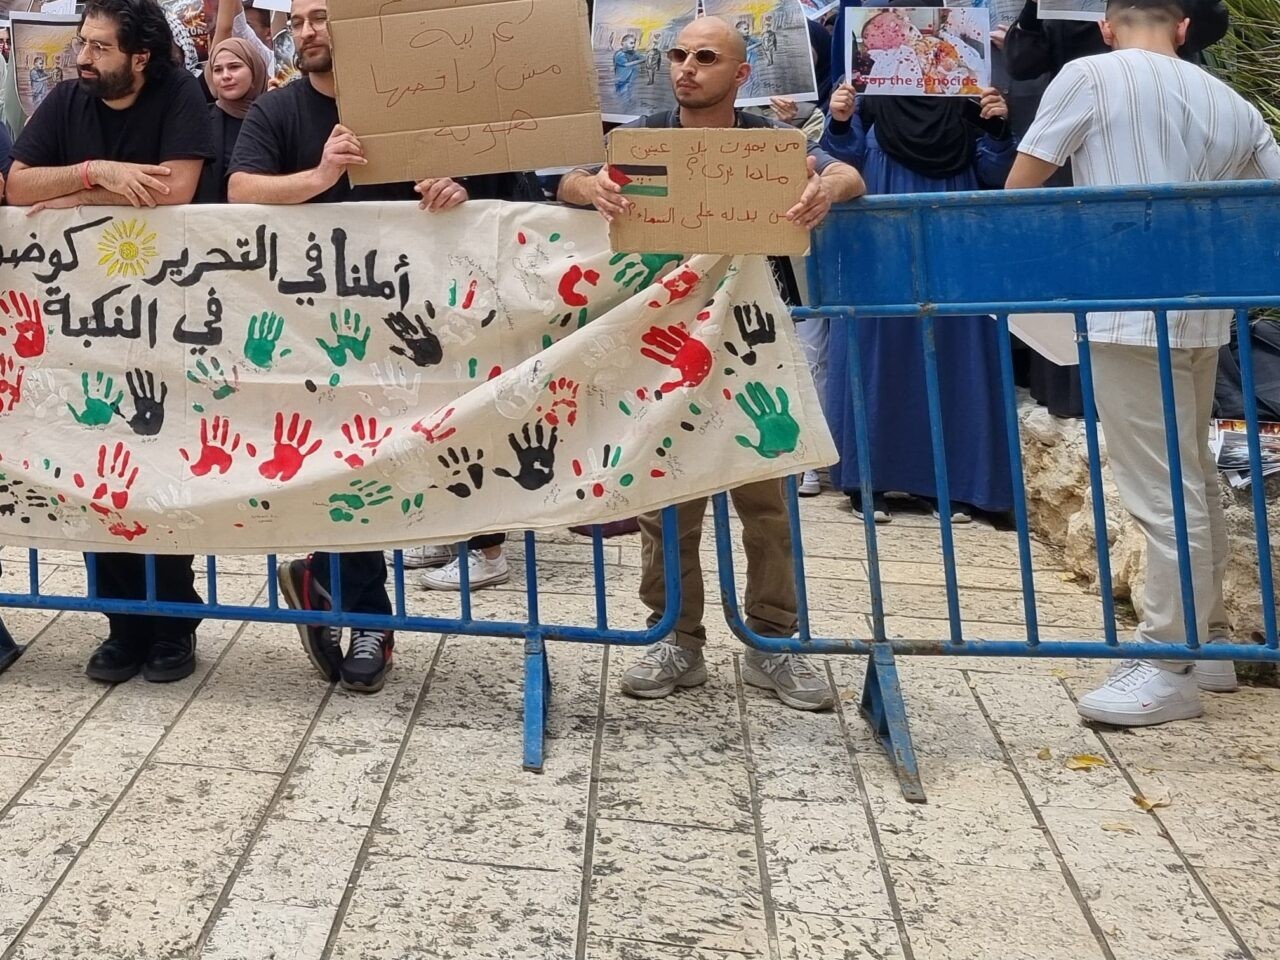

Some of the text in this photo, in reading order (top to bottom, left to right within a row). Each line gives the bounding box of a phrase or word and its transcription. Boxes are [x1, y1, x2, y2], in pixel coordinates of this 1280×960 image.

[410, 20, 514, 71] عربية
[495, 63, 562, 91] مش
[855, 74, 978, 88] Stop the genocide
[433, 109, 538, 156] هوية
[720, 141, 767, 158] يموت
[775, 141, 800, 153] من
[141, 223, 279, 287] التحرير
[278, 230, 327, 307] في
[331, 227, 410, 311] أملنا
[42, 284, 224, 356] في النكبة
